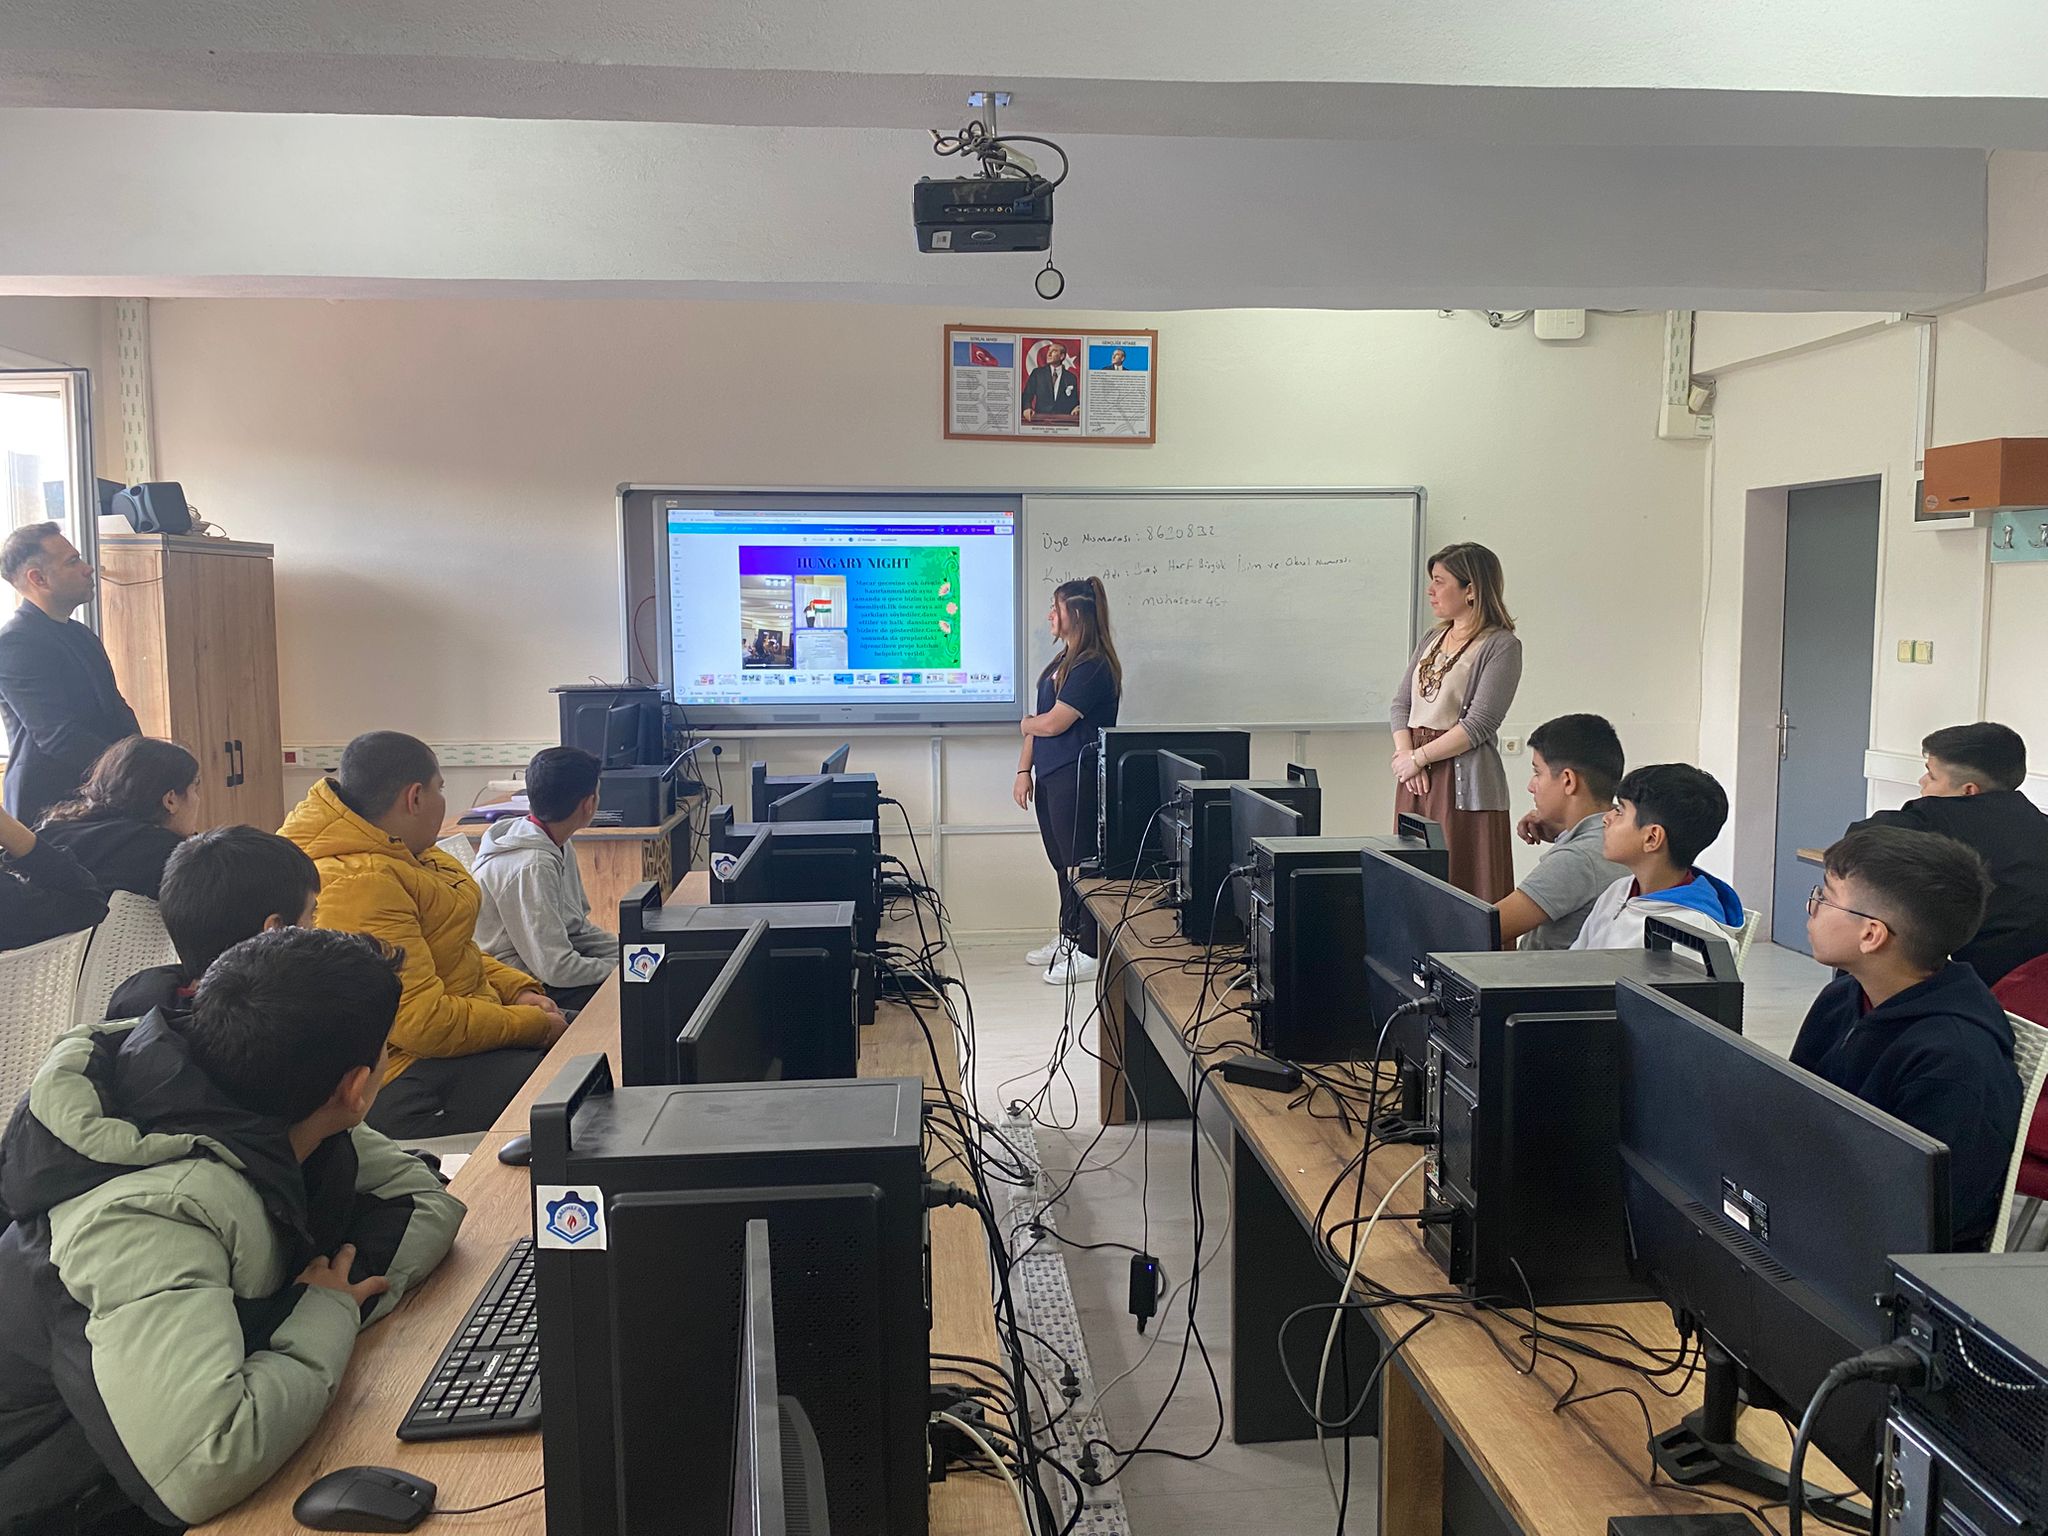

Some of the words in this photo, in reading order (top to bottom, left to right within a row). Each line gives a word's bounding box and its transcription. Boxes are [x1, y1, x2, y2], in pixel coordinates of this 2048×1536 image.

[1042, 532, 1069, 552] Üye
[797, 557, 863, 569] HUNGARY
[867, 557, 911, 569] NIGHT
[1267, 561, 1280, 570] ve
